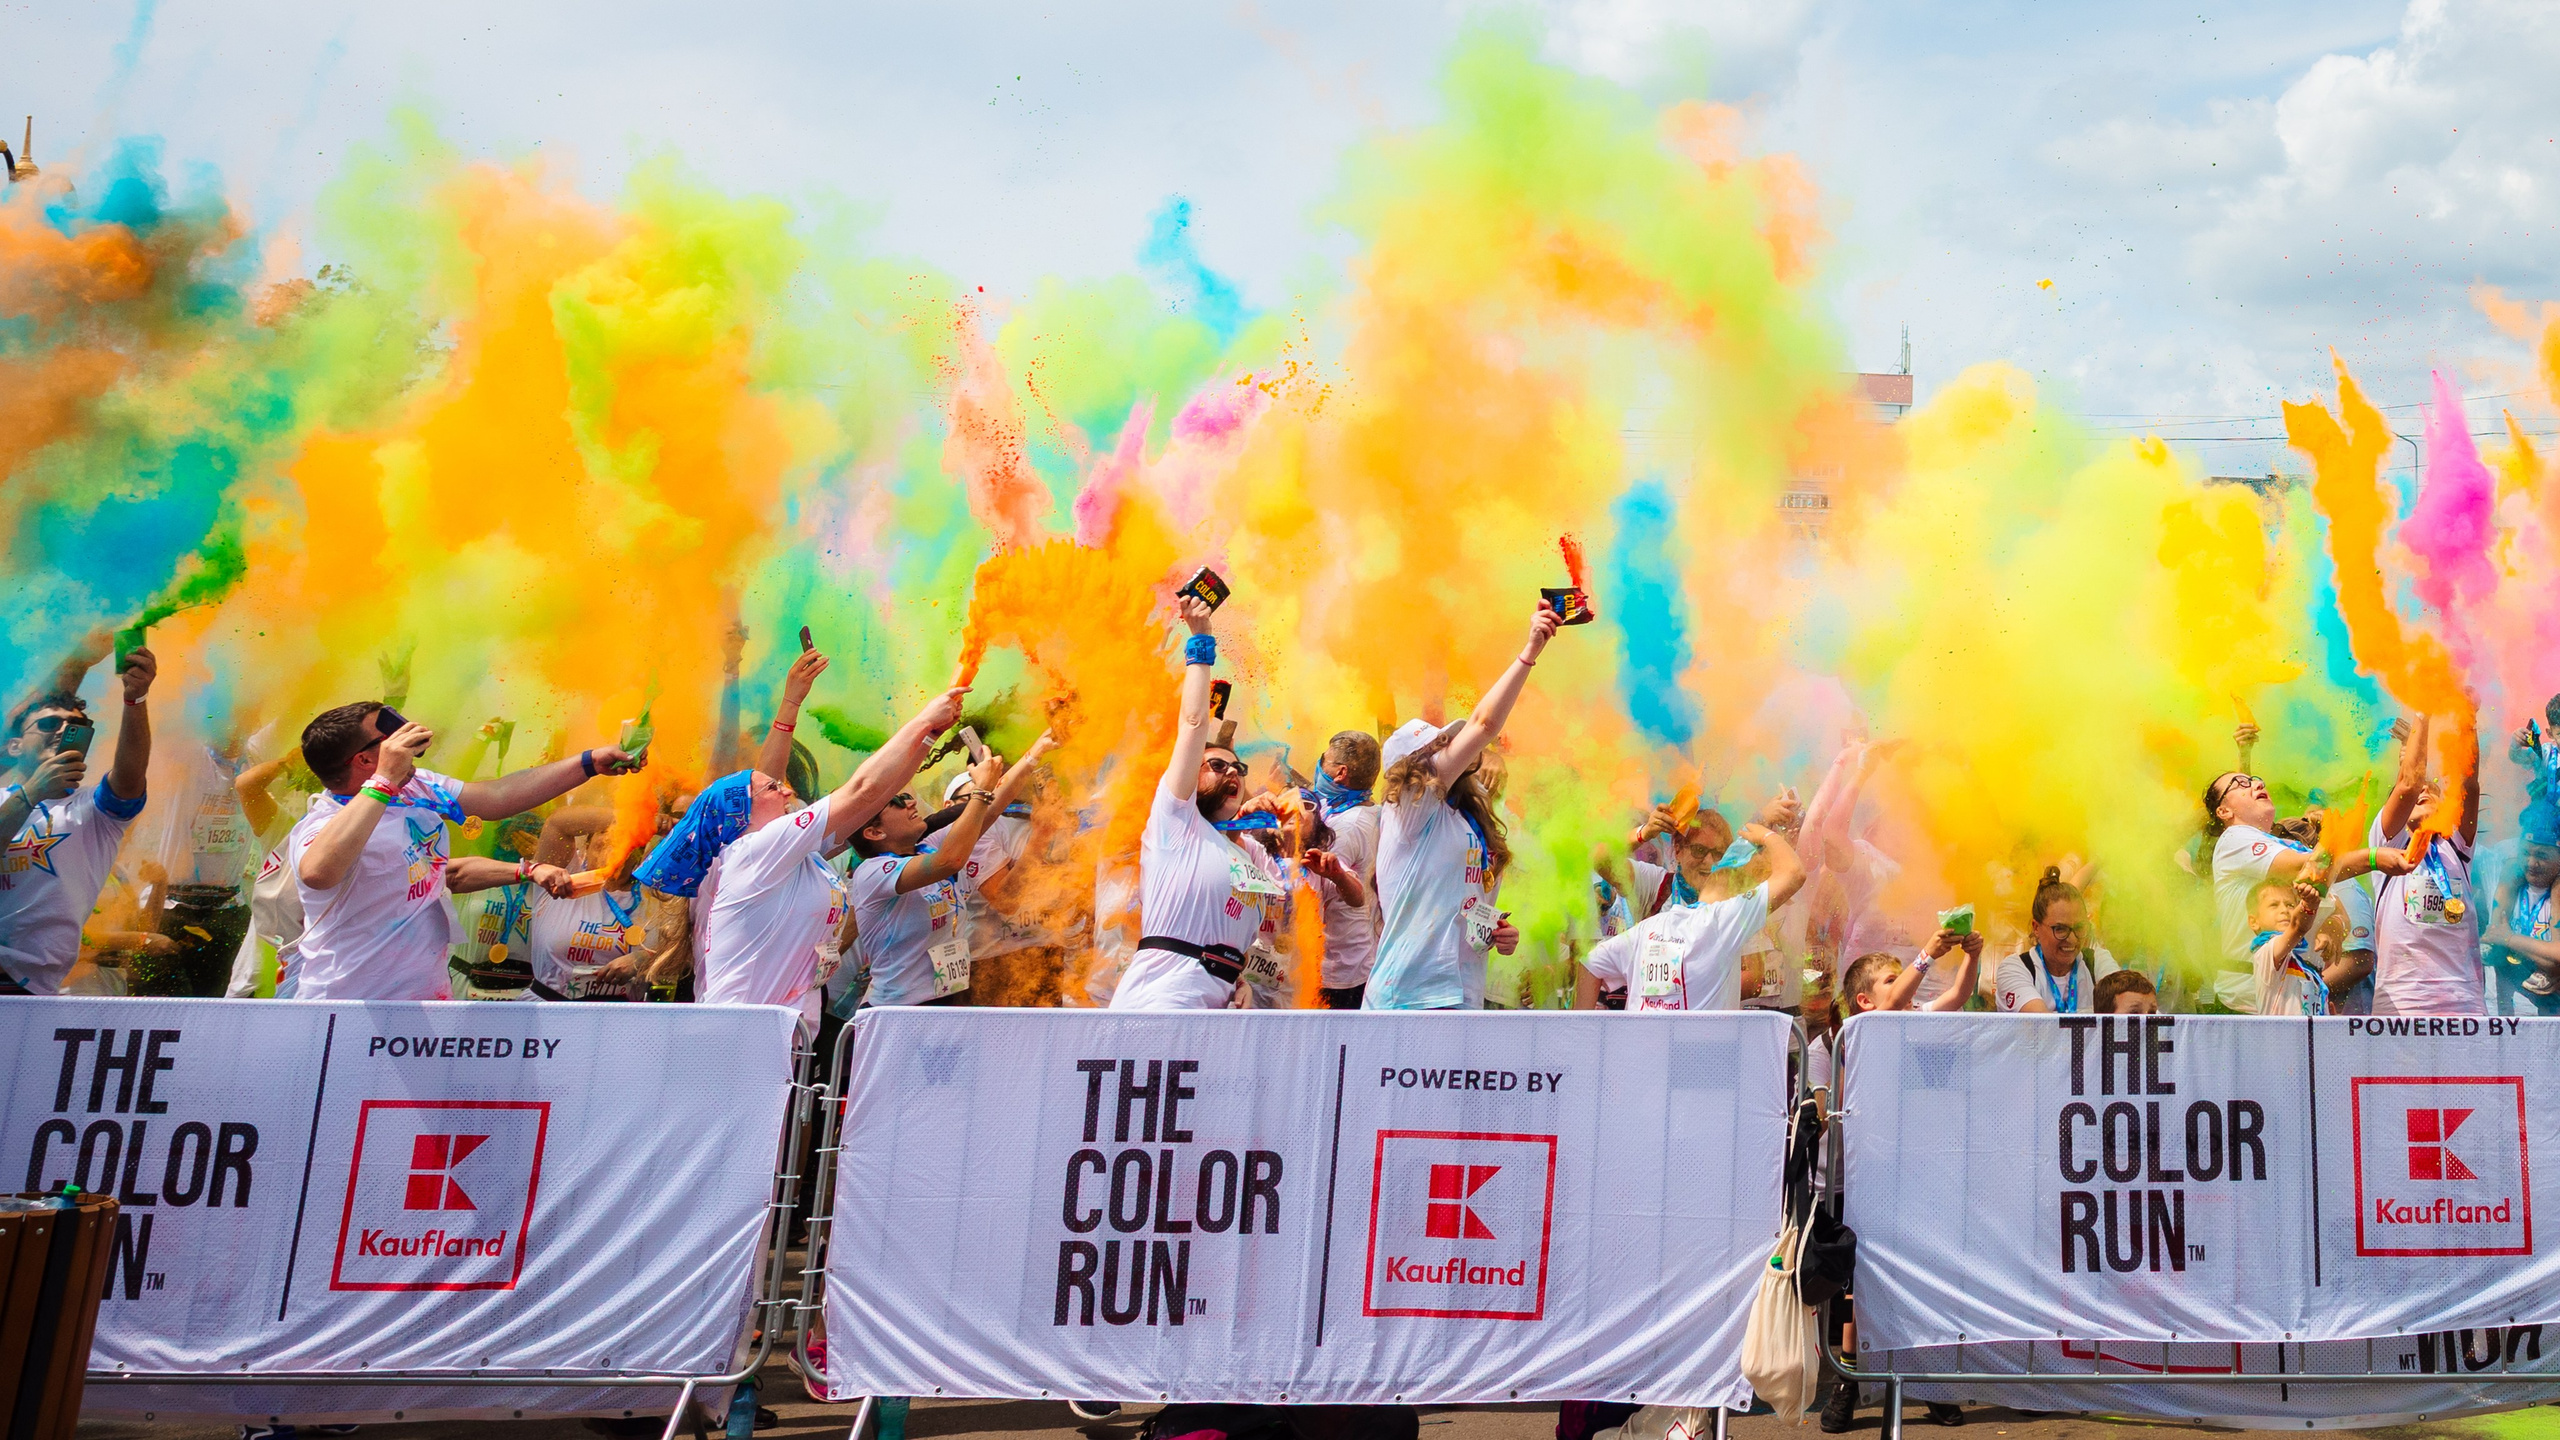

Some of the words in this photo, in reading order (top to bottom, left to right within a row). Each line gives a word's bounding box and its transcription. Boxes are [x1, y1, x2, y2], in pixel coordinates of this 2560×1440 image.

[1195, 580, 1218, 604] COLOR
[0, 856, 30, 874] LOR
[484, 900, 506, 917] THE
[2423, 895, 2446, 912] 1595
[578, 920, 602, 935] THE
[571, 931, 615, 952] COLOR
[946, 958, 969, 981] 16139
[1247, 953, 1278, 978] 17846
[1645, 963, 1669, 982] 18119
[2349, 1018, 2479, 1036] POWERED
[2488, 1018, 2520, 1036] BY
[368, 1036, 513, 1059] POWERED
[522, 1038, 561, 1060] BY
[2060, 1015, 2176, 1096] THE
[53, 1028, 181, 1114] THE
[1380, 1067, 1517, 1092] POWERED
[1527, 1072, 1564, 1094] BY
[1077, 1059, 1200, 1144] THE
[2059, 1100, 2267, 1184] COLOR
[25, 1120, 259, 1208] COLOR
[1062, 1148, 1284, 1235] COLOR
[2376, 1198, 2511, 1225] Kaufland
[357, 1228, 508, 1258] Kaufland
[2060, 1189, 2187, 1273] RUN
[1053, 1240, 1191, 1327] RUN
[1385, 1255, 1526, 1287] Kaufland
